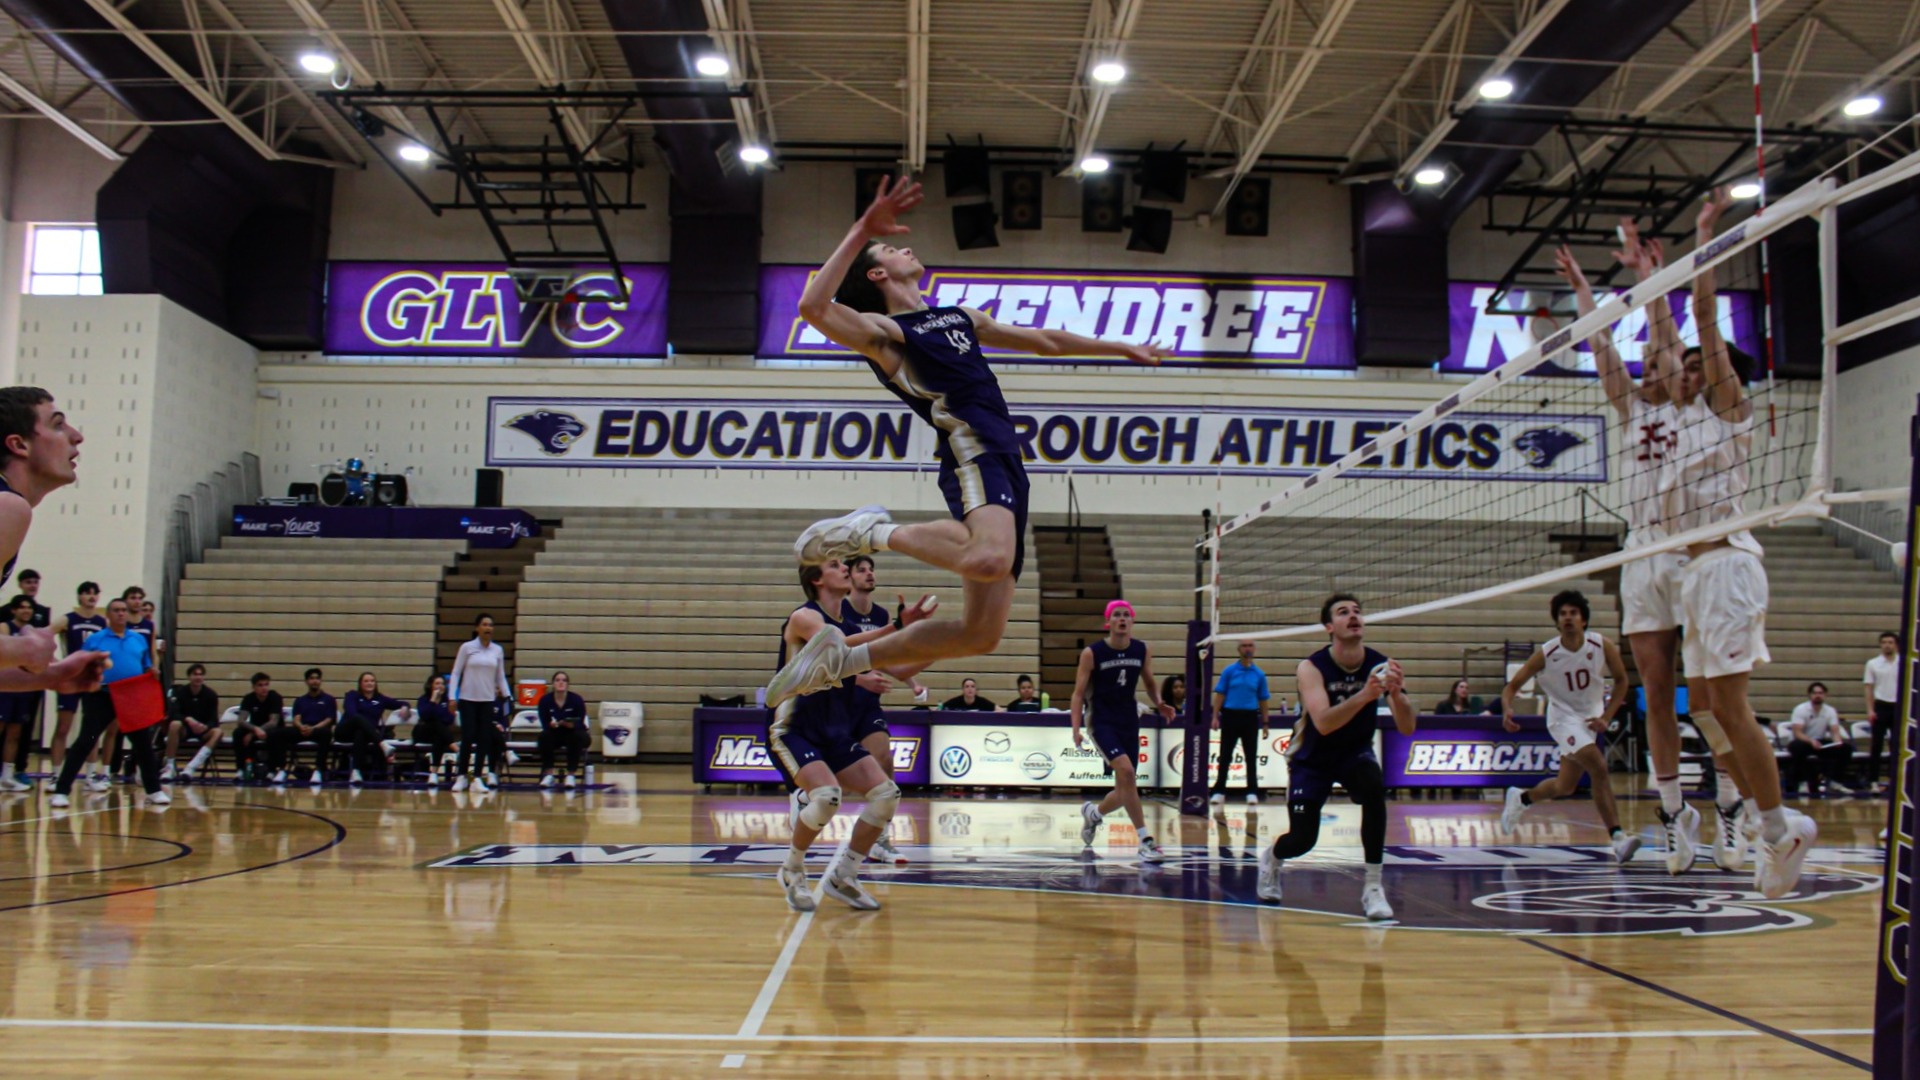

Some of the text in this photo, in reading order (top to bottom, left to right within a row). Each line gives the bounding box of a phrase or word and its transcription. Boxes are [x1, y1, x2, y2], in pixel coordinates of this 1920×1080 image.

[361, 270, 632, 348] GLVC
[593, 410, 912, 461] EDUCATION
[241, 522, 267, 531] MAKE
[467, 526, 495, 534] MAKE
[1117, 669, 1127, 687] 4
[1565, 668, 1590, 692] 10
